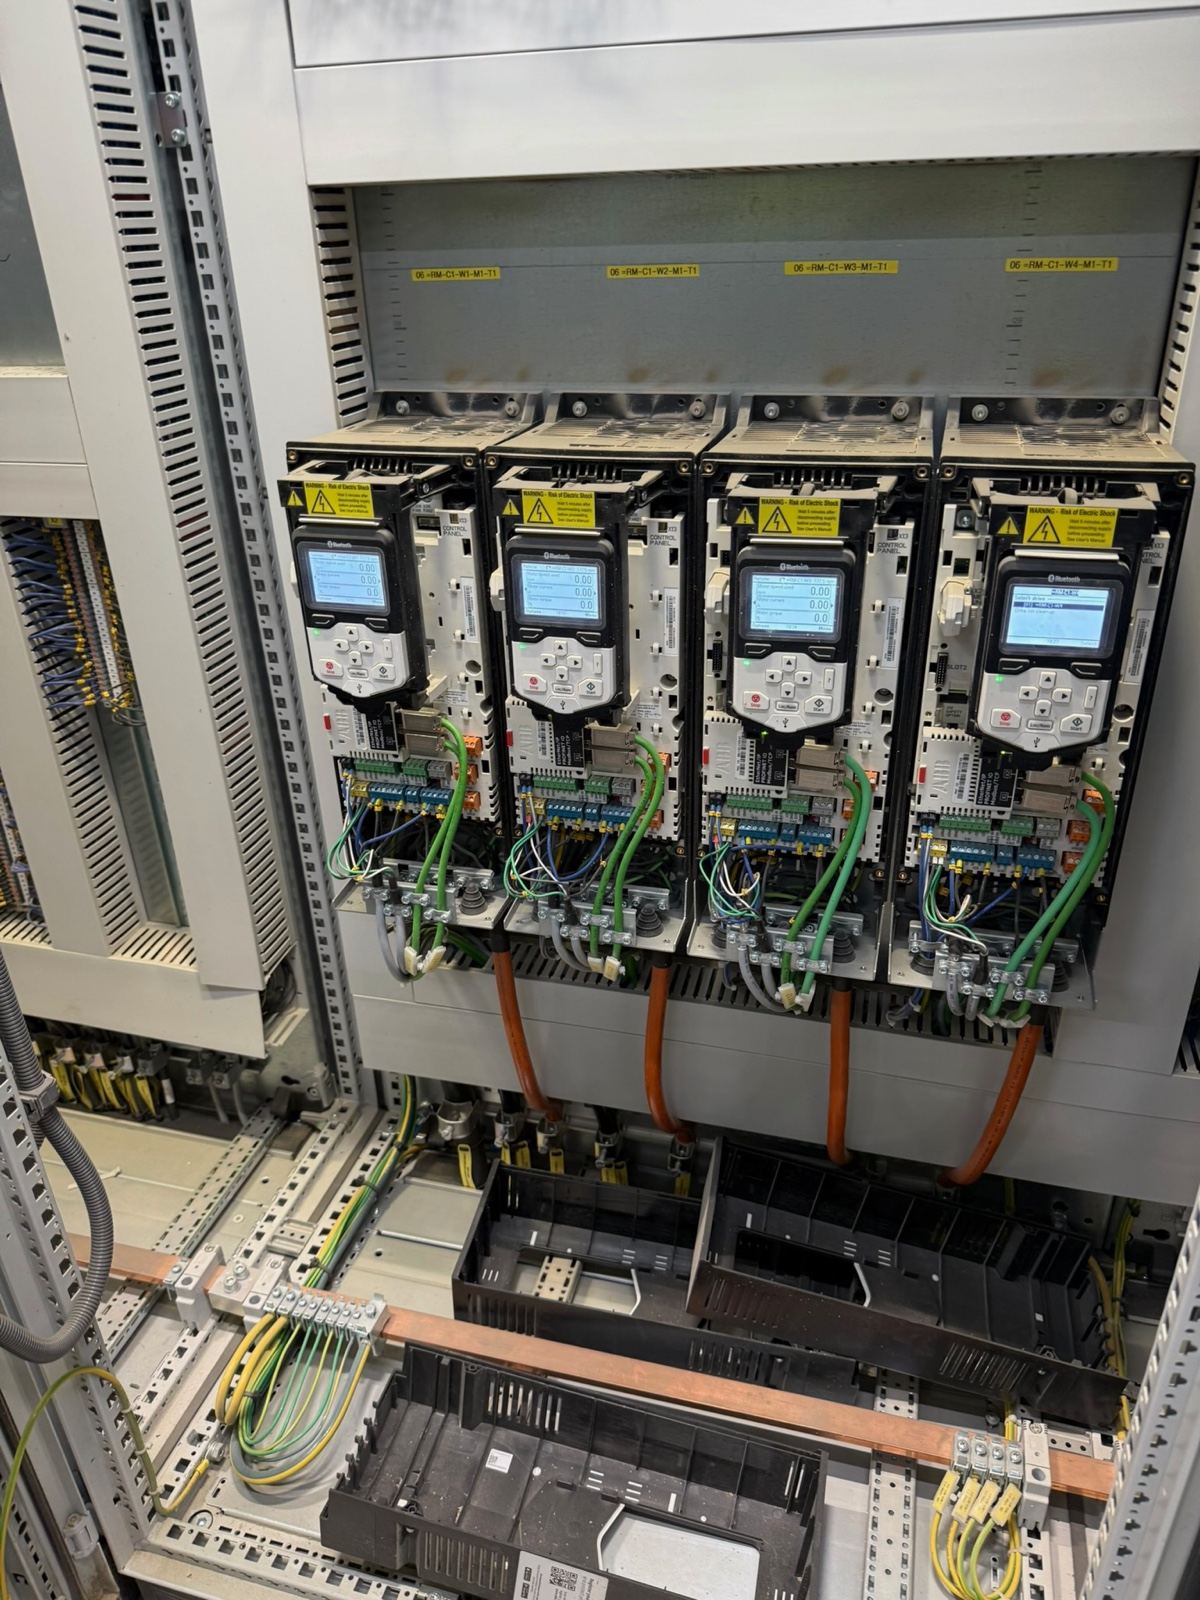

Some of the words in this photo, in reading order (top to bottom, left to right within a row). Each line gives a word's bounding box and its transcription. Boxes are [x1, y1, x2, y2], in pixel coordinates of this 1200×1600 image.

[794, 264, 804, 272] 06
[1010, 260, 1020, 270] 06
[610, 268, 620, 276] 06
[575, 575, 592, 584] 0.00
[575, 588, 592, 597] 0.00
[810, 586, 830, 596] 0.00
[581, 601, 592, 610] 0.0
[810, 600, 828, 609] 0.00
[814, 613, 828, 623] 0.0
